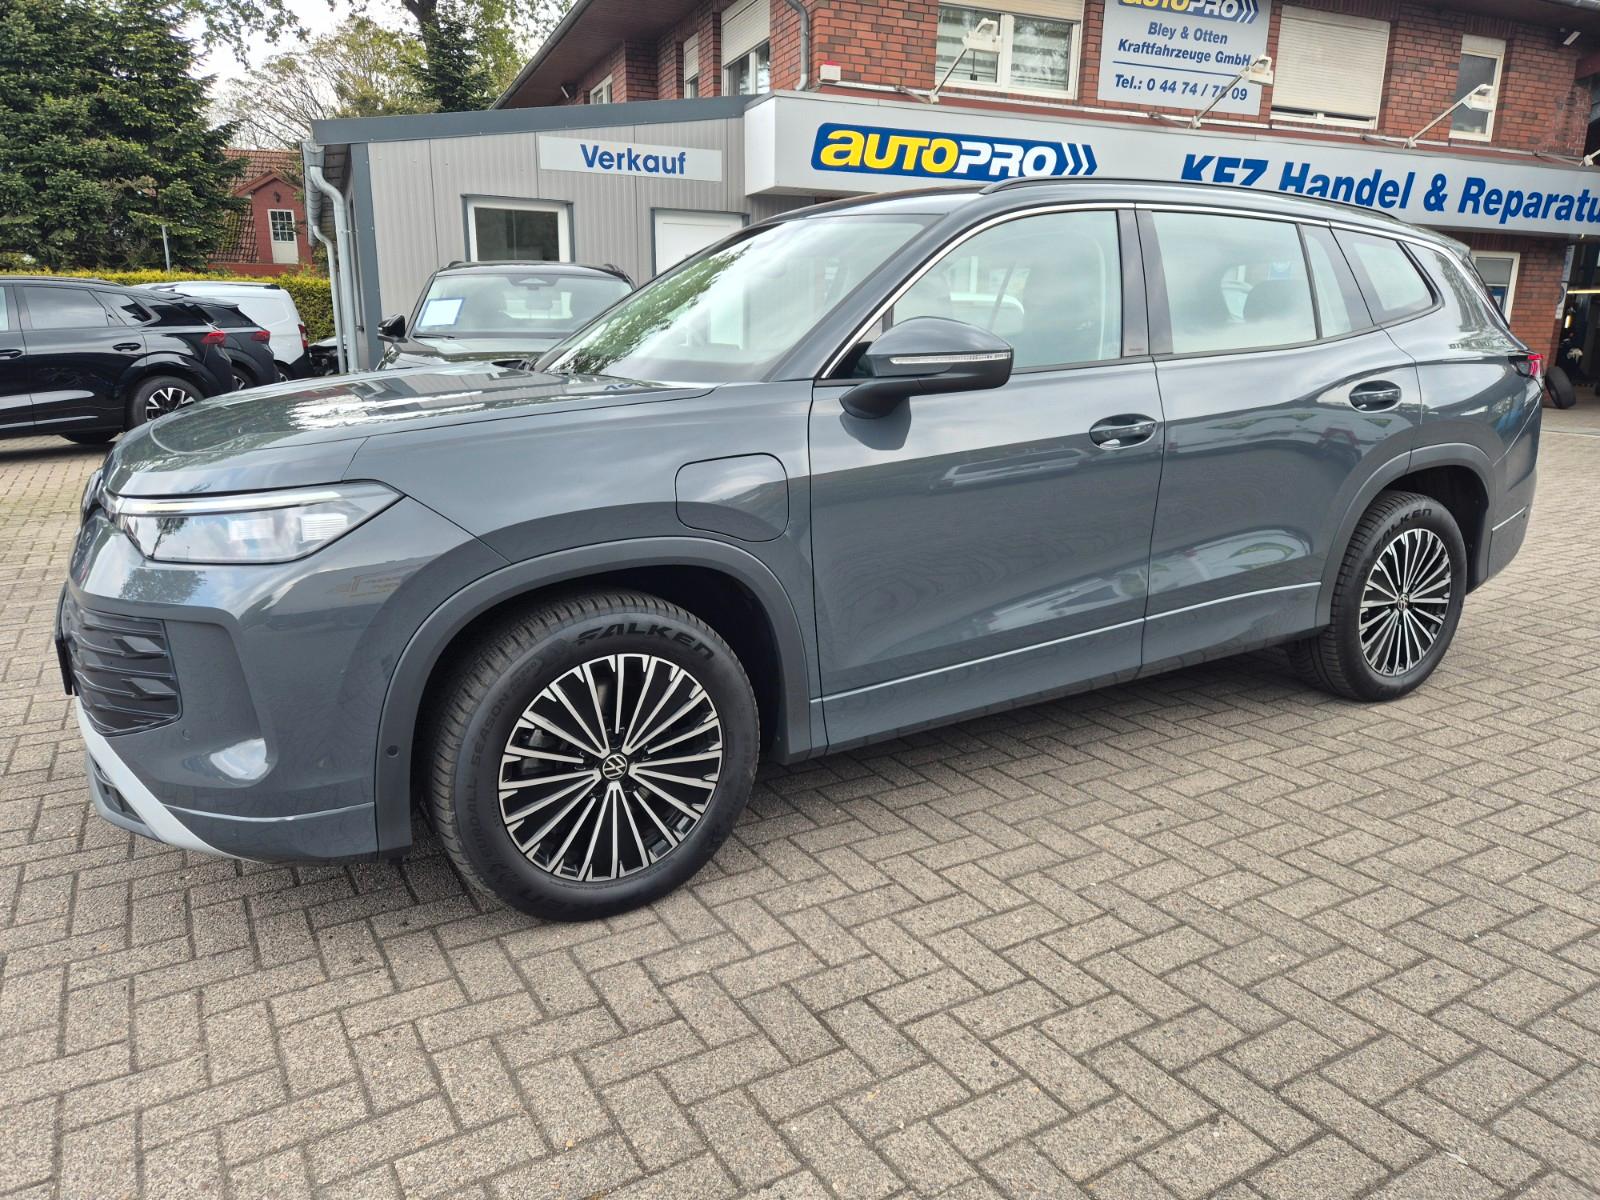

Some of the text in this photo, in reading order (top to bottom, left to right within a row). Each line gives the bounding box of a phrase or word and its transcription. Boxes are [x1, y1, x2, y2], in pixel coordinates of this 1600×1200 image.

[1148, 21, 1228, 45] Bley & Otten
[1117, 38, 1251, 67] Kraftfahrzeuge GmbH
[1115, 74, 1143, 90] Tel.:
[1146, 78, 1156, 91] 0
[1160, 80, 1177, 93] 44
[1181, 82, 1198, 95] 74
[1200, 83, 1208, 97] /
[1231, 87, 1248, 100] 09
[580, 143, 687, 175] Verkauf
[1181, 153, 1269, 187] KFZ
[1278, 161, 1416, 209] Handel
[1423, 173, 1448, 212] &
